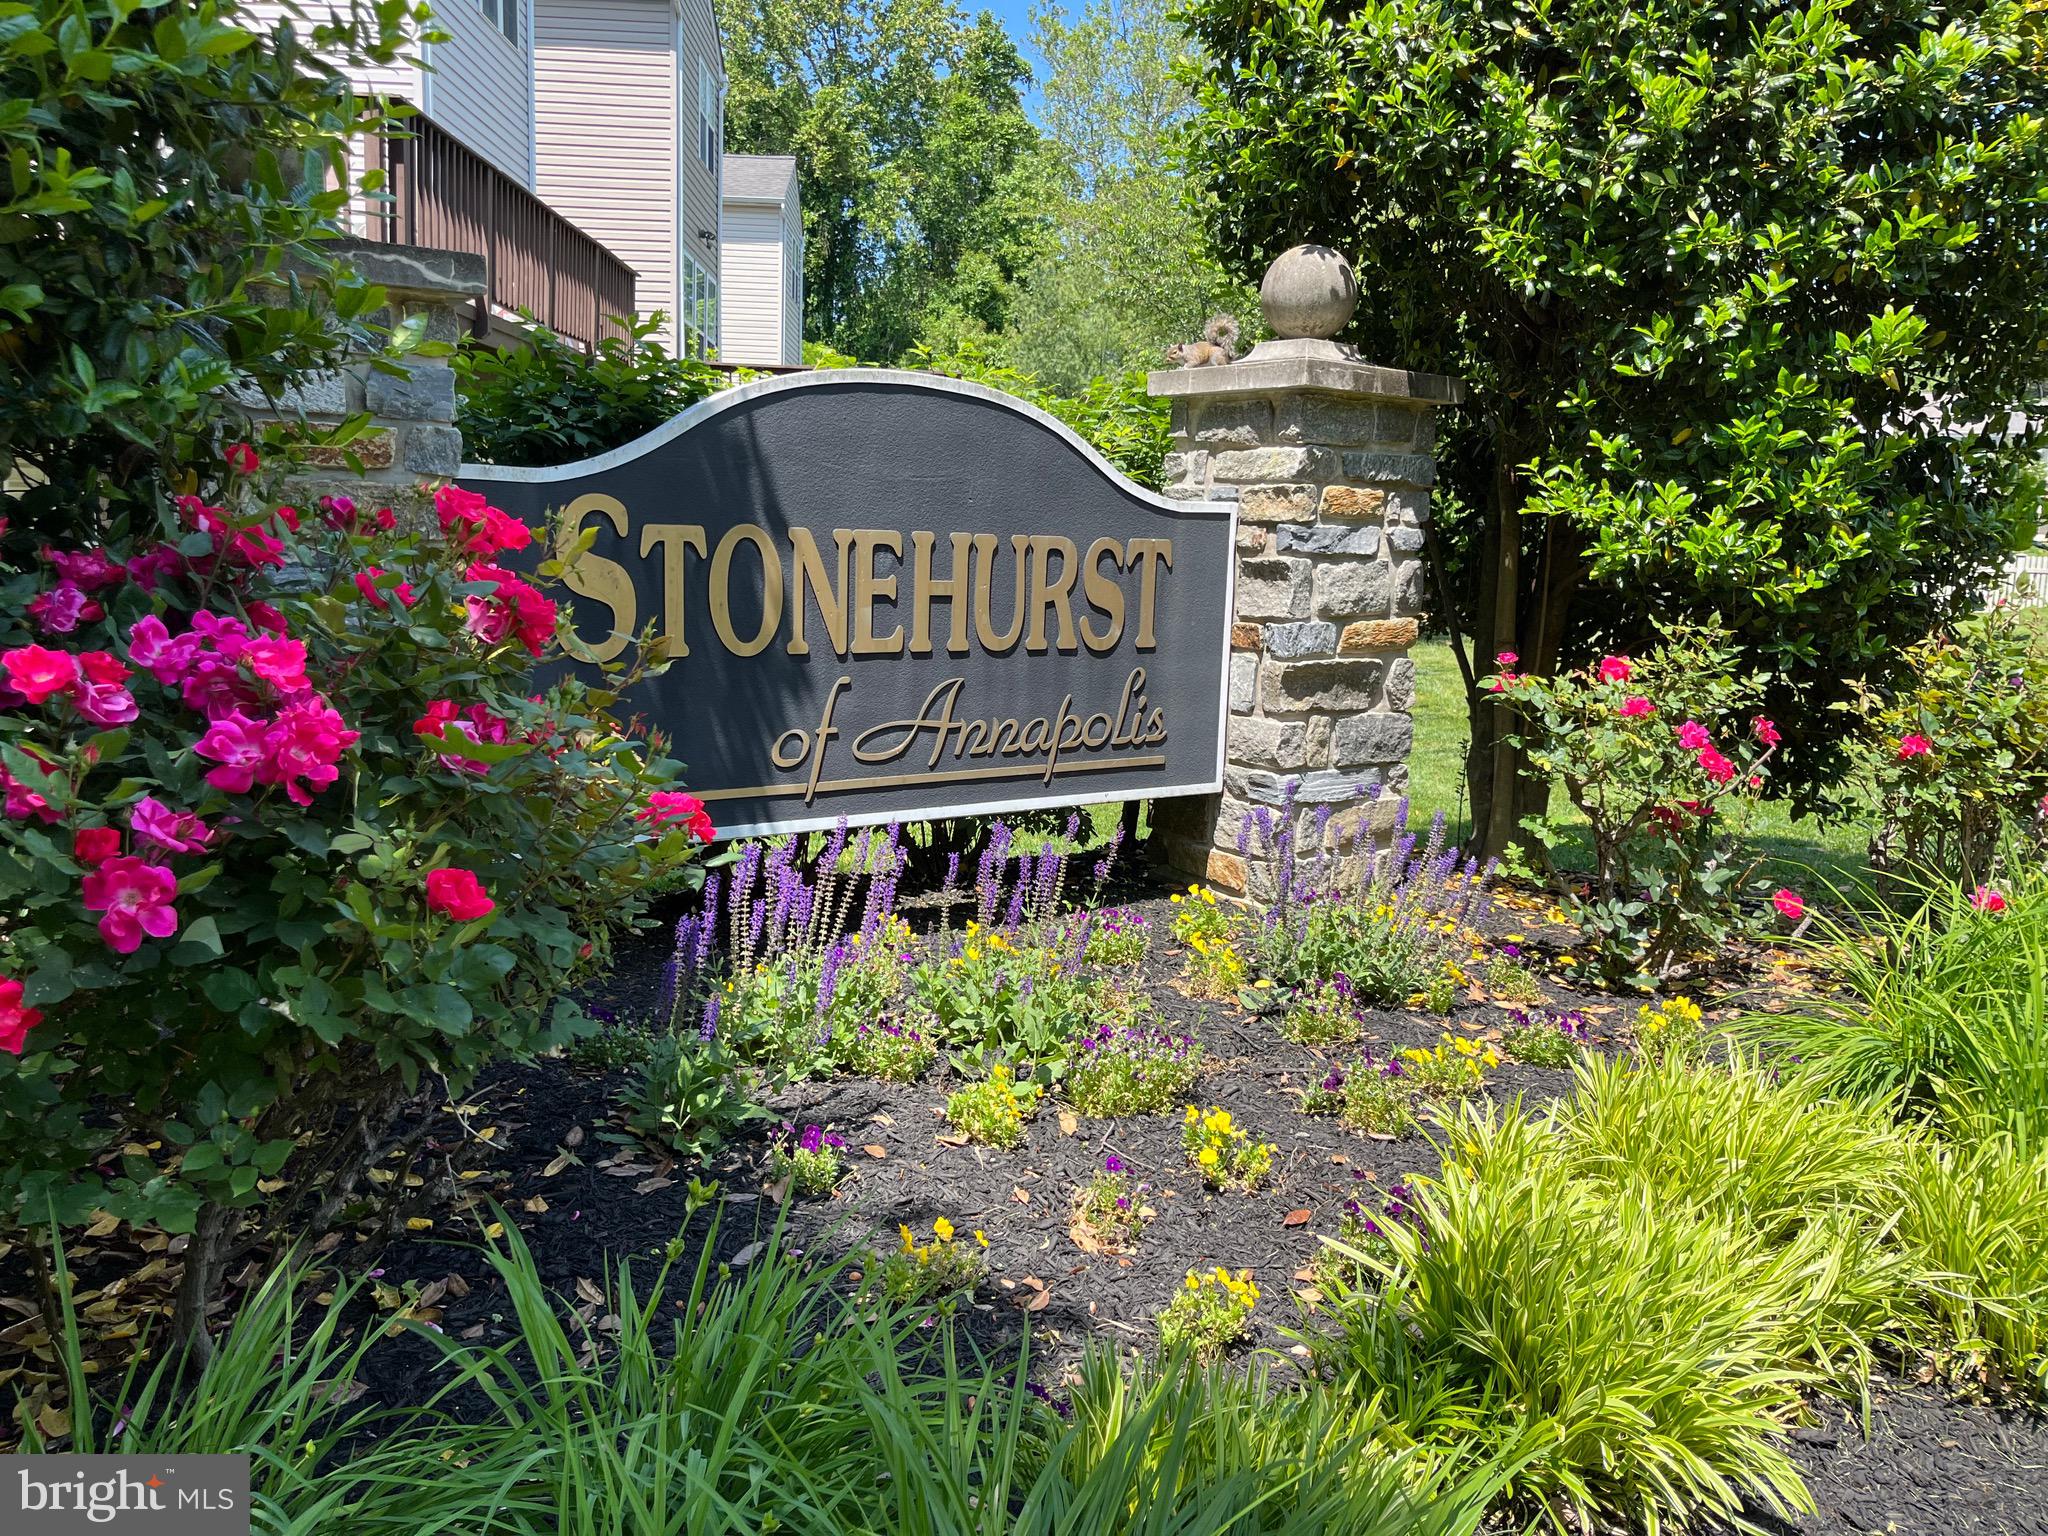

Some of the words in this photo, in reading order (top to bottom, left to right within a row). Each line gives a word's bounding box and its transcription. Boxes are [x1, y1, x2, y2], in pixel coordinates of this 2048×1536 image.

[556, 493, 1172, 663] STONEHURST
[772, 676, 851, 803] of
[852, 667, 1167, 783] Annapolis
